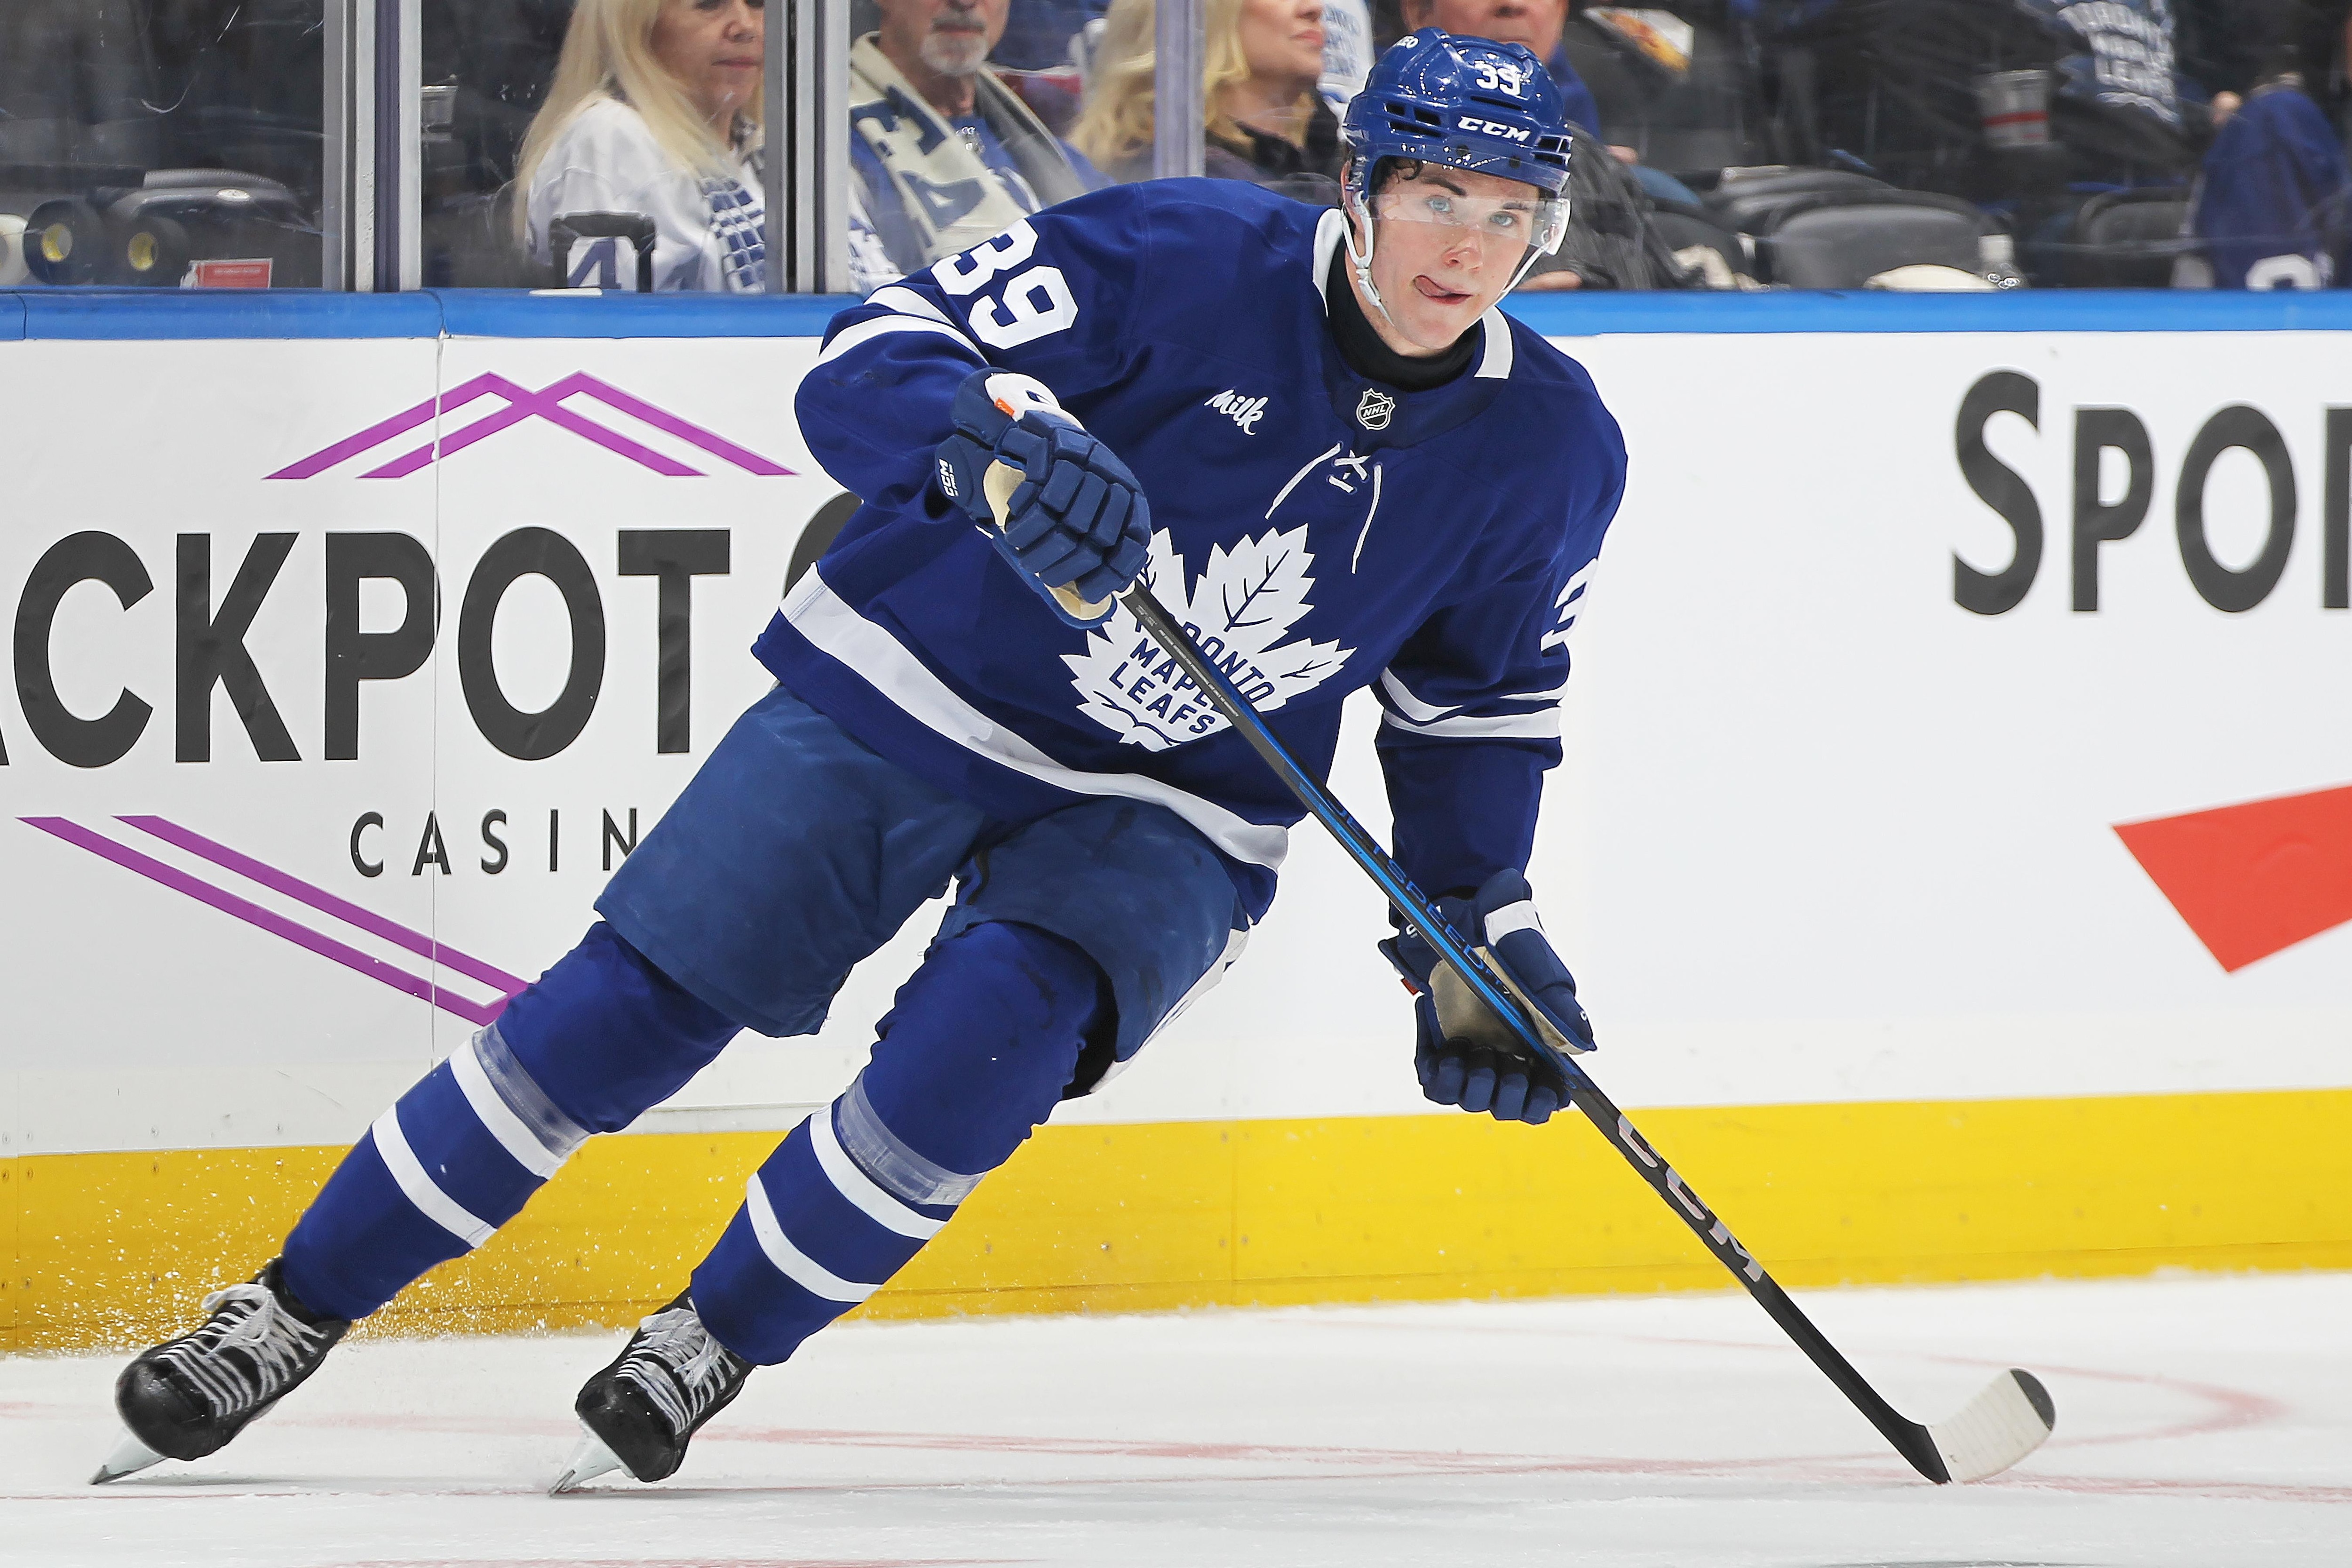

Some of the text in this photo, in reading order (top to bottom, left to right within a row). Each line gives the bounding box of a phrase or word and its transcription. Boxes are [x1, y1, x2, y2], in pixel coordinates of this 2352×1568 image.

[1474, 60, 1521, 96] 39
[1458, 116, 1531, 142] CCM
[930, 219, 1079, 350] 39
[1204, 389, 1269, 436] Milk
[1363, 405, 1386, 417] NHL
[939, 459, 955, 497] CCM
[1954, 370, 2352, 615] SPO
[0, 526, 731, 768] CKPOT
[1129, 638, 1225, 714] MAPL
[1135, 619, 1275, 703] RONTO
[1109, 661, 1216, 734] LEAFS
[350, 808, 637, 878] CASIN
[1617, 1113, 1764, 1282] CCM
